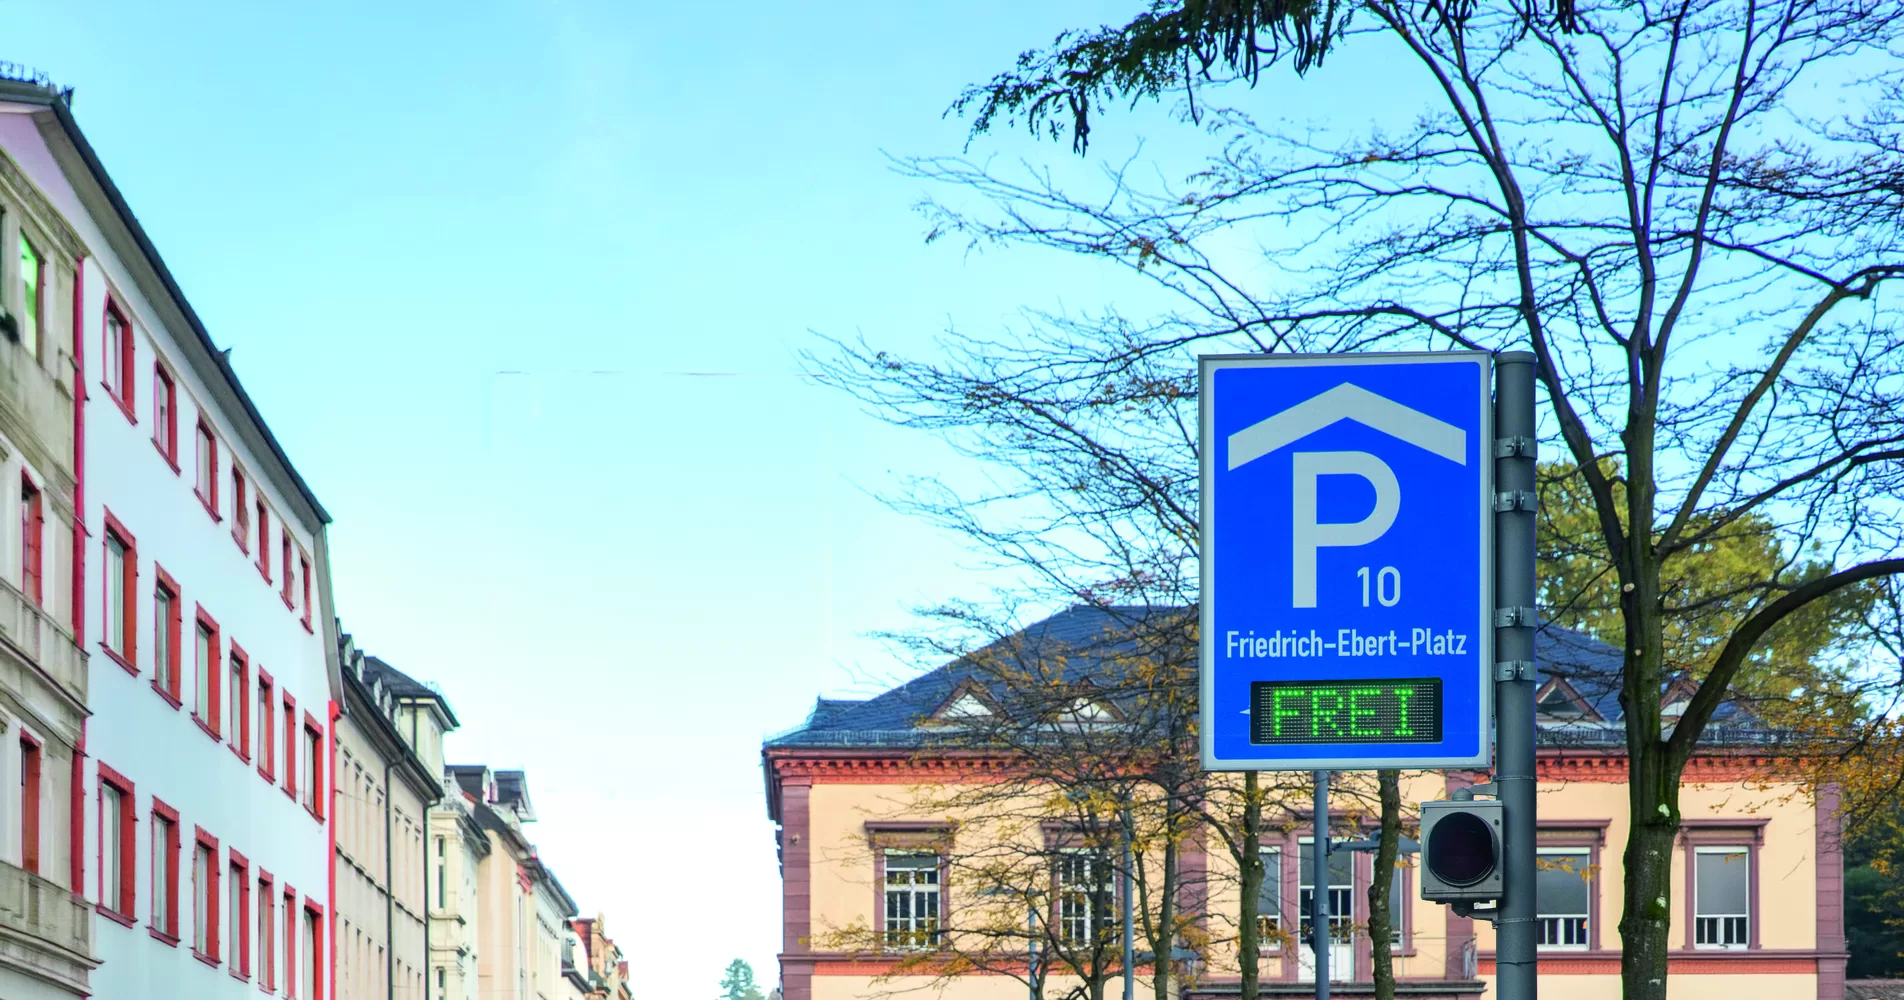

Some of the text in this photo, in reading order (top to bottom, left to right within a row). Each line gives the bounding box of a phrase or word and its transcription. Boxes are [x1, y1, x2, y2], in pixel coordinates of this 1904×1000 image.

[1292, 450, 1401, 609] P
[1356, 566, 1401, 608] 10
[1226, 627, 1468, 659] Friedrich-Ebert-Platz
[1273, 688, 1414, 737] FREI
